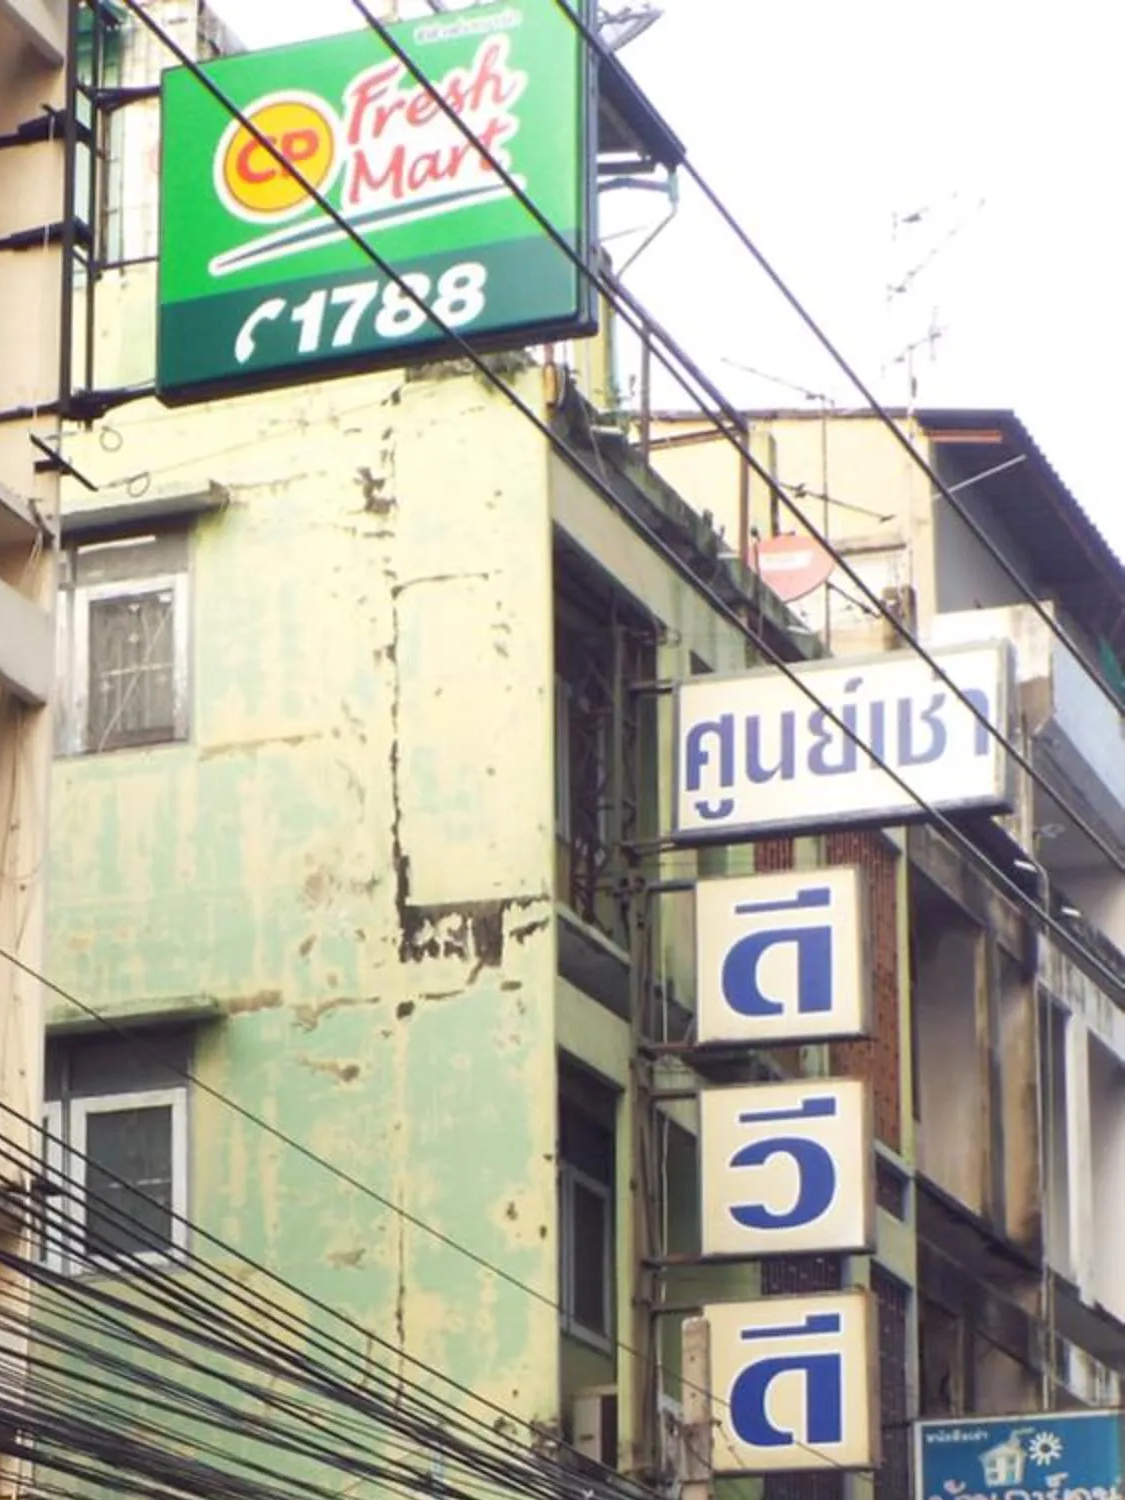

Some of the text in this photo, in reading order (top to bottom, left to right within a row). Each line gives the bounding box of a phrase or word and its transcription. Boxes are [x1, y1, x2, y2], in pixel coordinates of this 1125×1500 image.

[346, 42, 520, 146] Fresh
[236, 128, 319, 185] CP
[348, 118, 515, 206] Mart
[291, 262, 488, 355] 1788
[685, 667, 991, 819] ศูนย์เช่า
